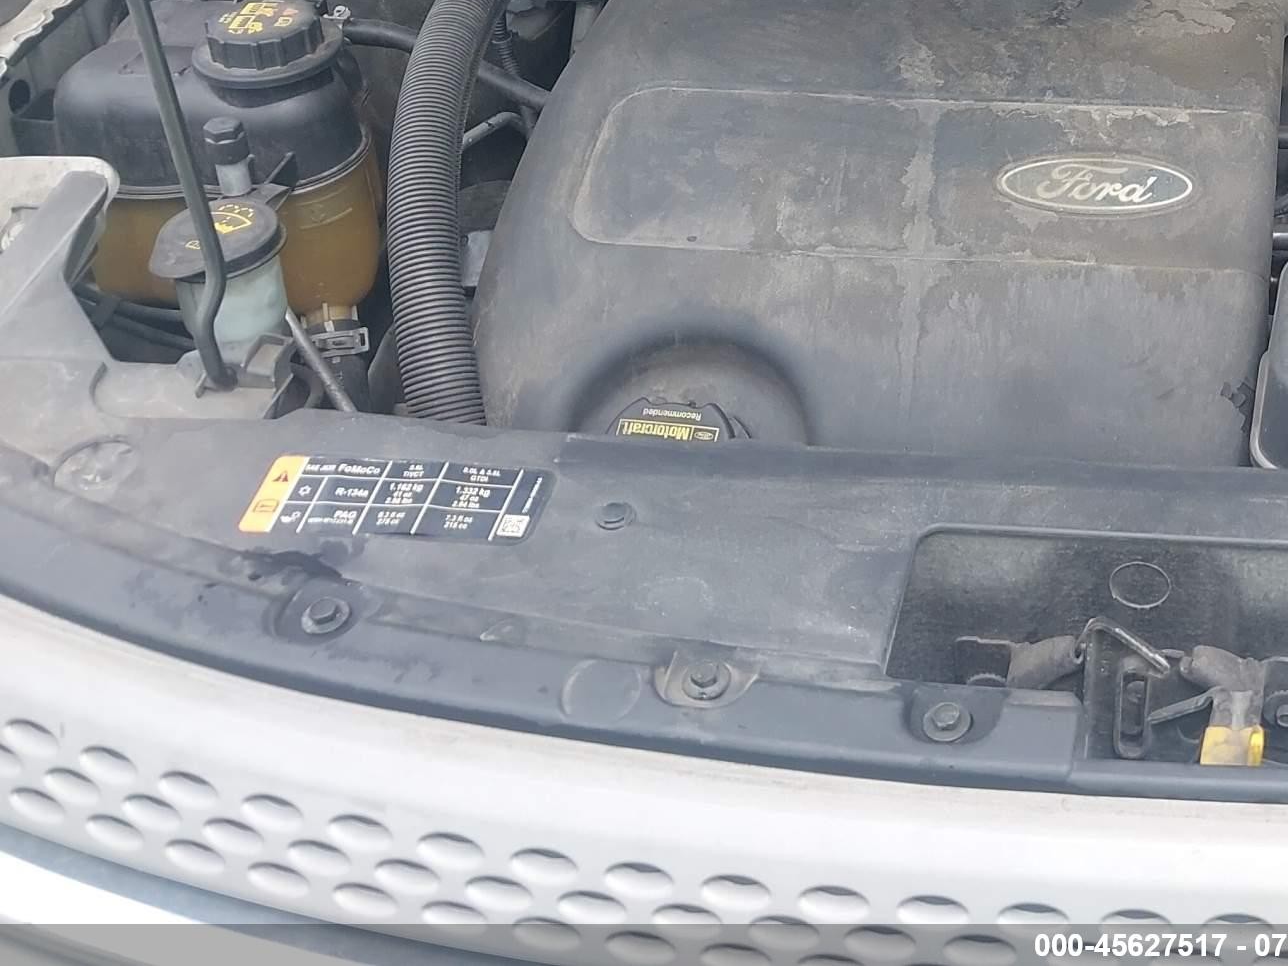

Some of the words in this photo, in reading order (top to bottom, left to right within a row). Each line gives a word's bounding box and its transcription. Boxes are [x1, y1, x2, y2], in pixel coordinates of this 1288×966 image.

[1036, 163, 1158, 203] Ford
[642, 408, 702, 422] Recommended
[622, 421, 691, 442] Motorcraft
[338, 463, 381, 475] FoMoCo
[335, 486, 369, 498] R-134a
[412, 484, 424, 493] kg
[479, 488, 491, 498] kg
[334, 510, 358, 519] PAG
